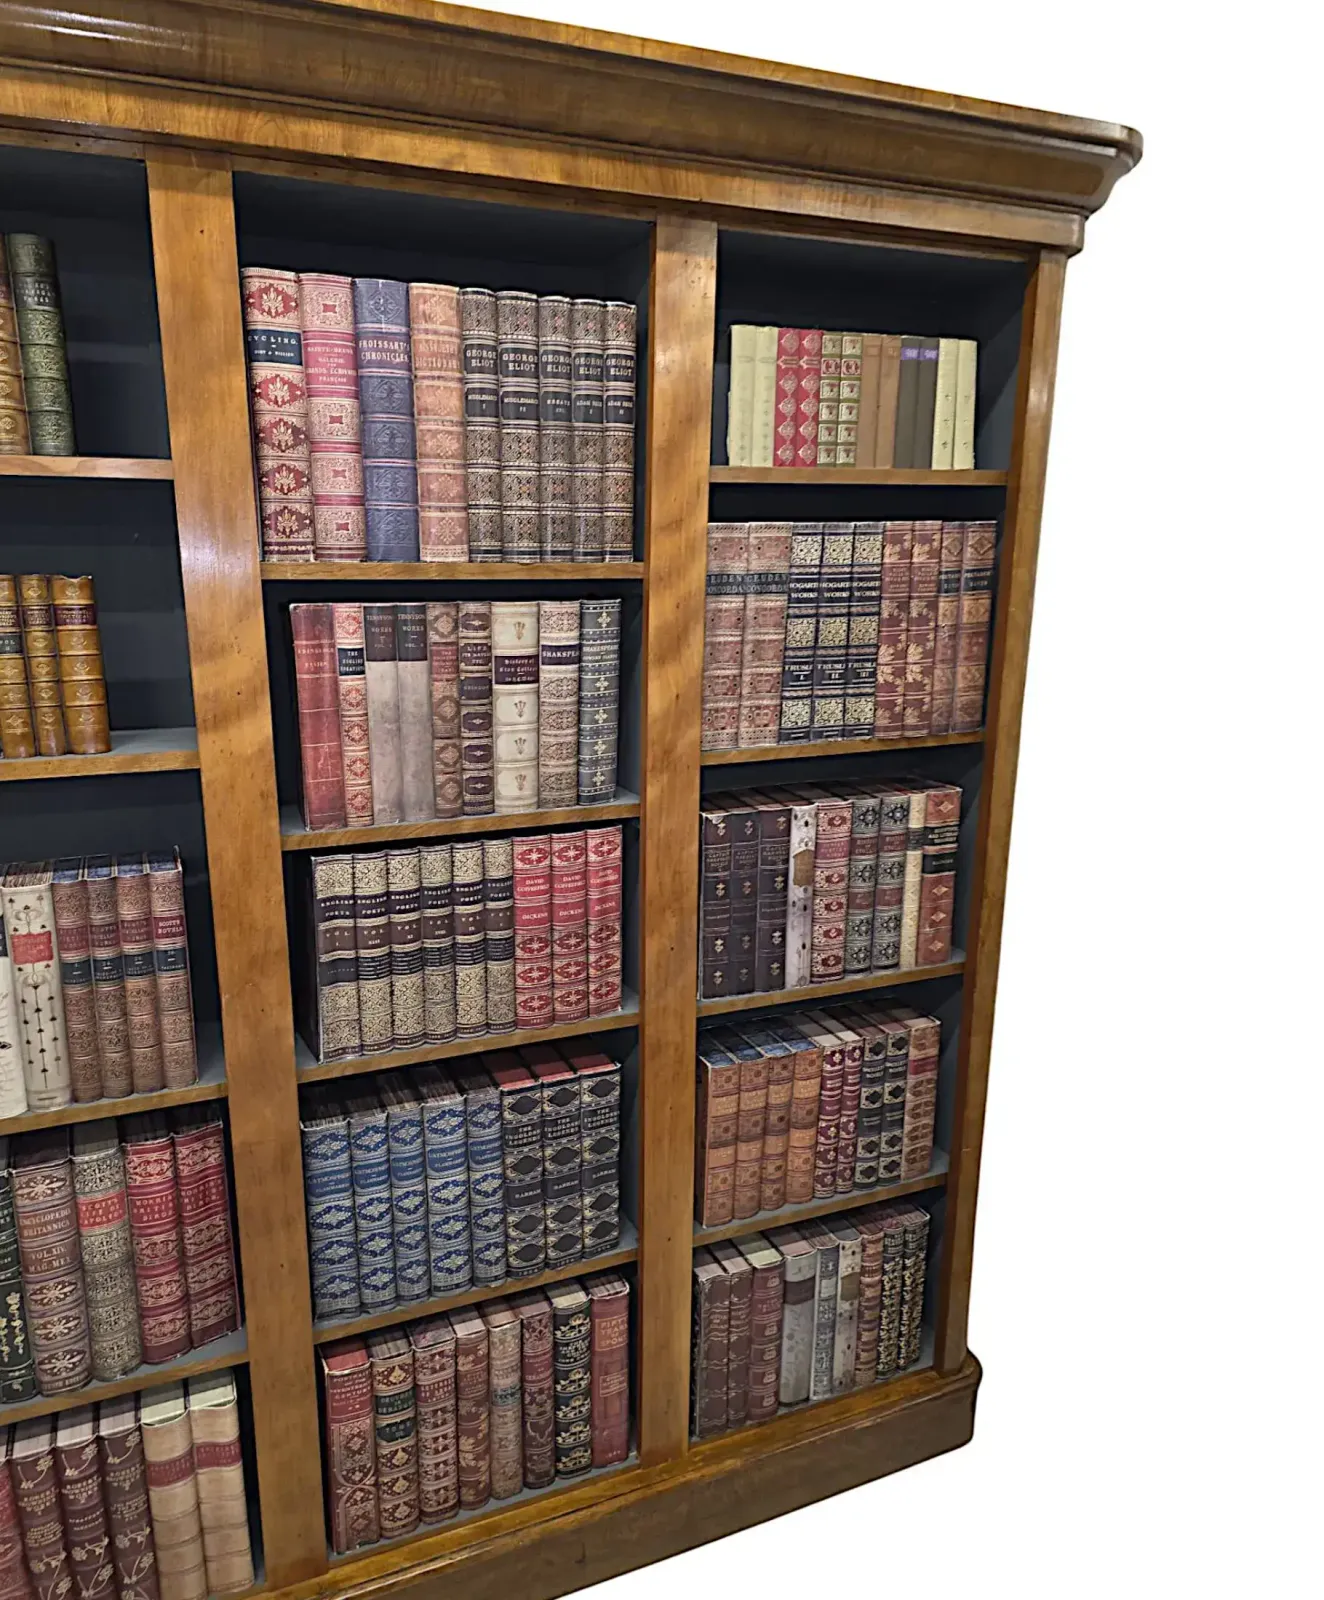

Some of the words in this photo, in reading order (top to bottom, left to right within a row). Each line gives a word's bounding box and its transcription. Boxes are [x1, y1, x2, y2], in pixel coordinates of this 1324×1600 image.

[466, 349, 497, 359] GEORGE
[502, 353, 538, 363] GEORGE
[471, 359, 494, 368] ELIOT
[508, 362, 536, 371] ELIOT
[606, 358, 634, 368] GEORGE
[547, 364, 570, 373] ELIOT
[579, 366, 601, 376] ELIOT
[610, 367, 632, 376] ELIOT
[456, 884, 483, 892] ENGLISH
[357, 896, 387, 904] ENGLISH
[391, 892, 420, 900] ENGLISH
[321, 899, 353, 907] ENGLISH
